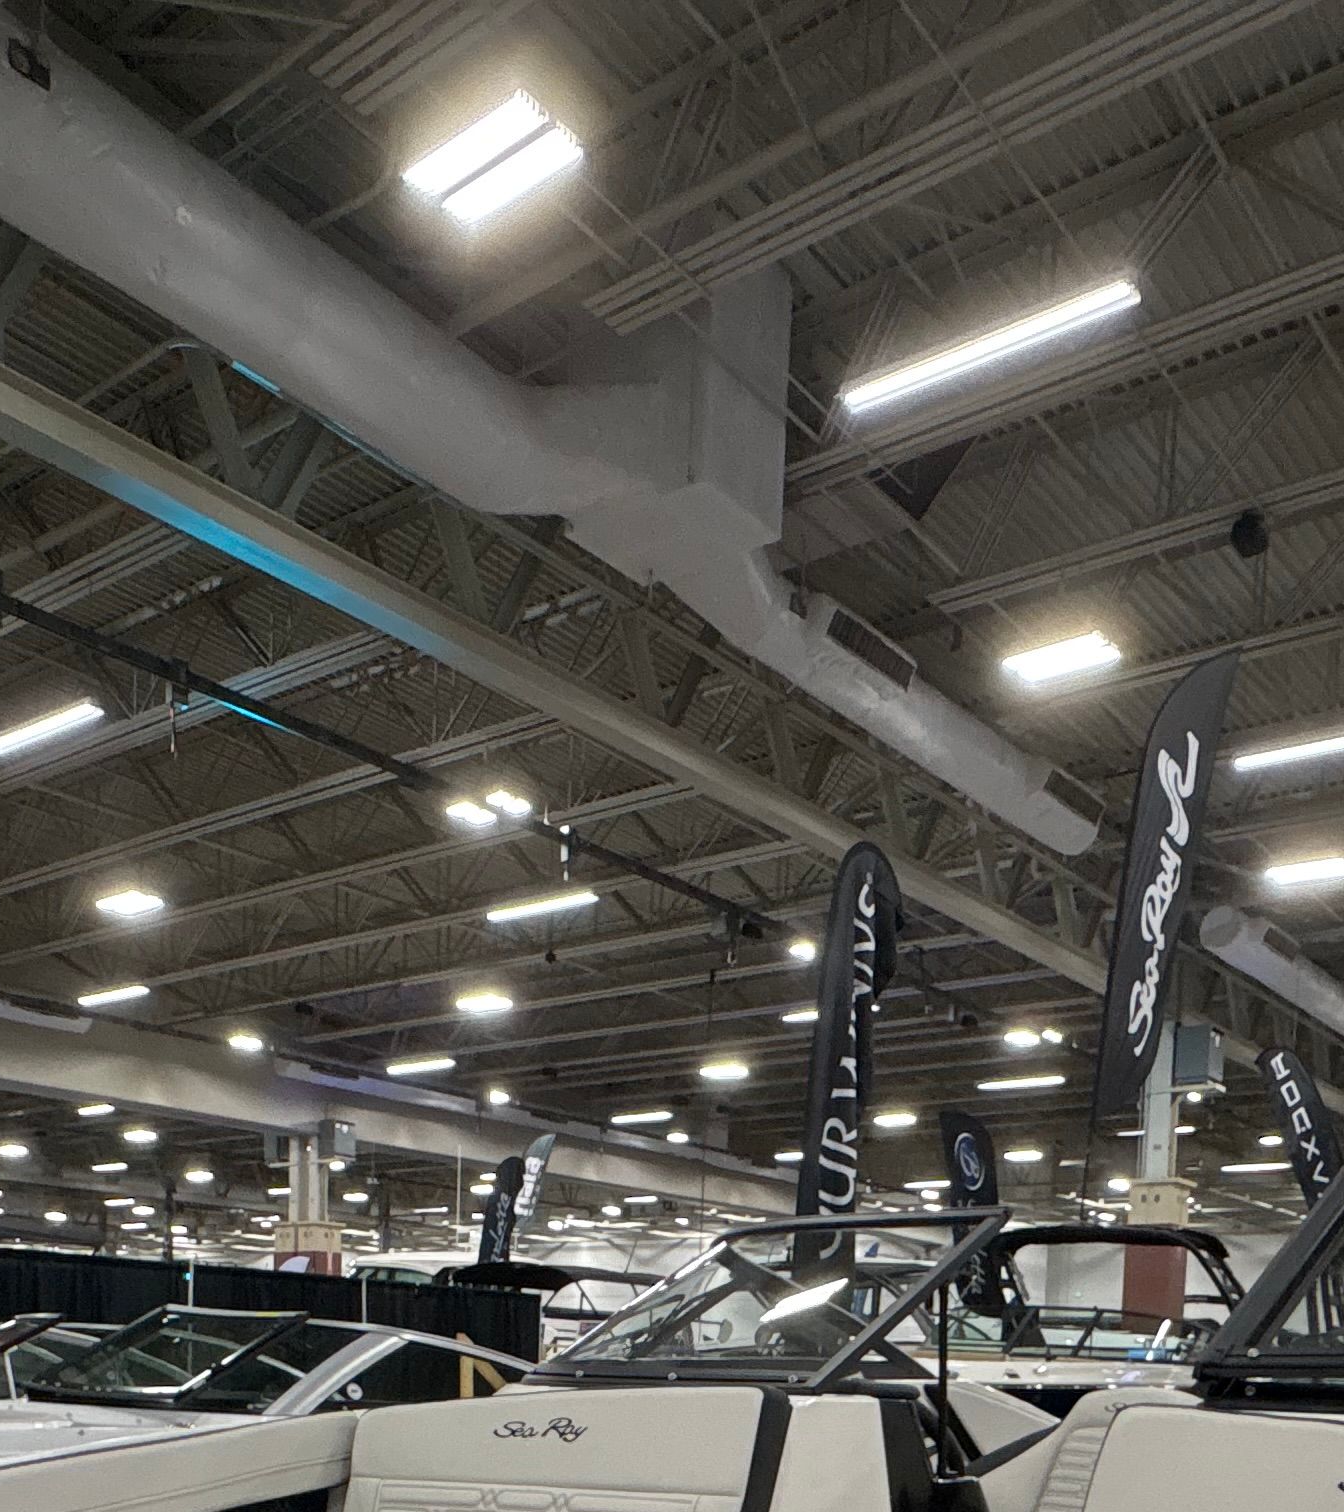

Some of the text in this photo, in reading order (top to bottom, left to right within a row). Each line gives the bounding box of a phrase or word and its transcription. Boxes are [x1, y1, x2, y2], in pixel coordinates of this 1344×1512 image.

[1269, 1051, 1331, 1199] AXDOR
[493, 1416, 588, 1443] Sea Ray
